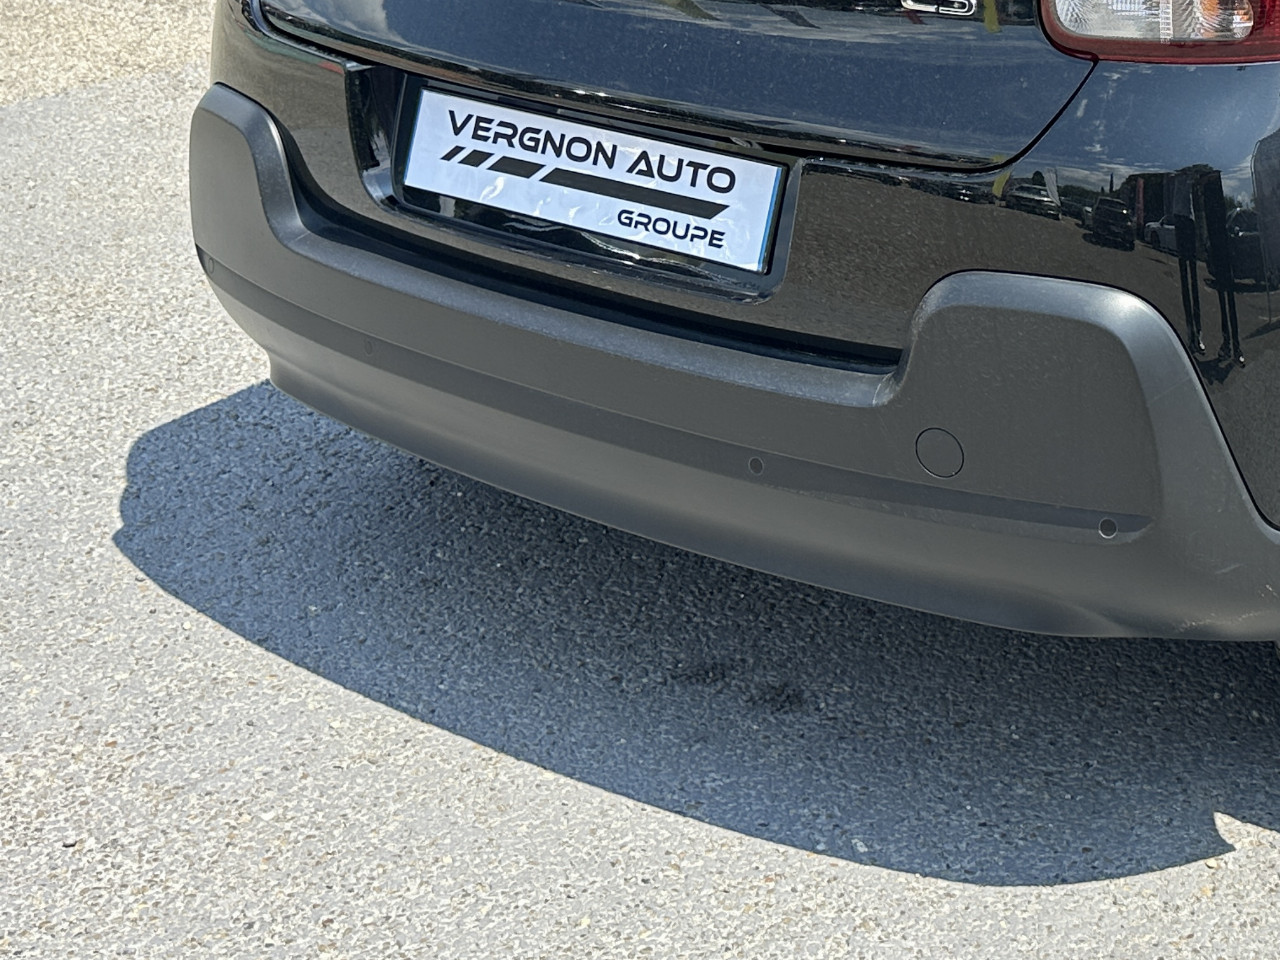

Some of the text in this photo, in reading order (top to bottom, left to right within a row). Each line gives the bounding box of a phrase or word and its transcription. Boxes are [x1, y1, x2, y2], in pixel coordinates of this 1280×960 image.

[448, 109, 736, 194] VERGNON AUTO
[617, 209, 726, 249] GROUPE
